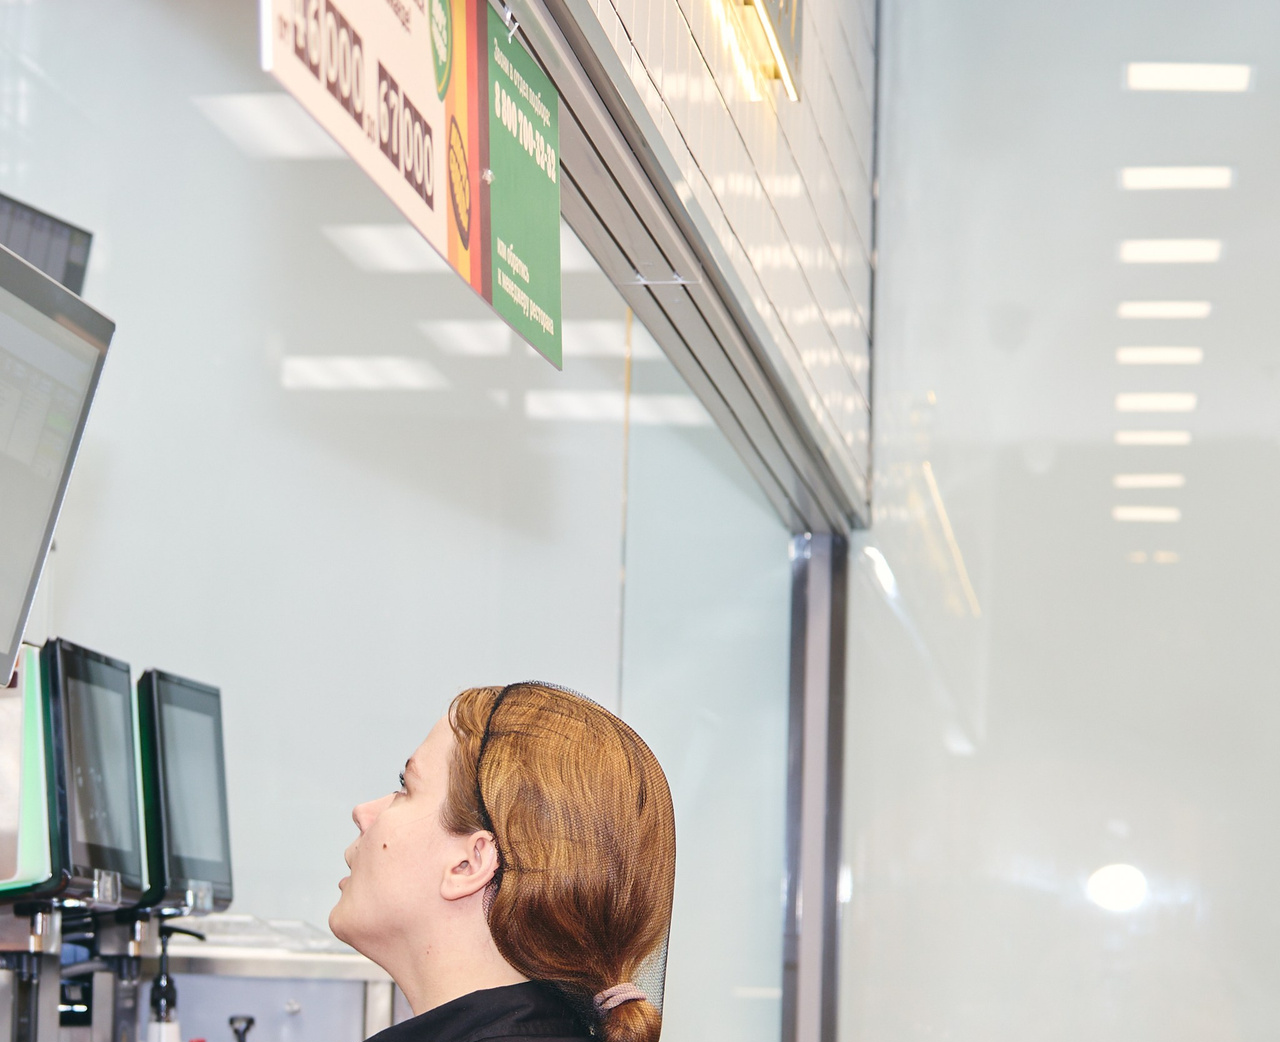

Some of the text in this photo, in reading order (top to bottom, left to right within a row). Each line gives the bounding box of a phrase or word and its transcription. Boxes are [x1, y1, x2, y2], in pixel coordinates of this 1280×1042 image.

[494, 80, 557, 184] 8 800 700-32-32
